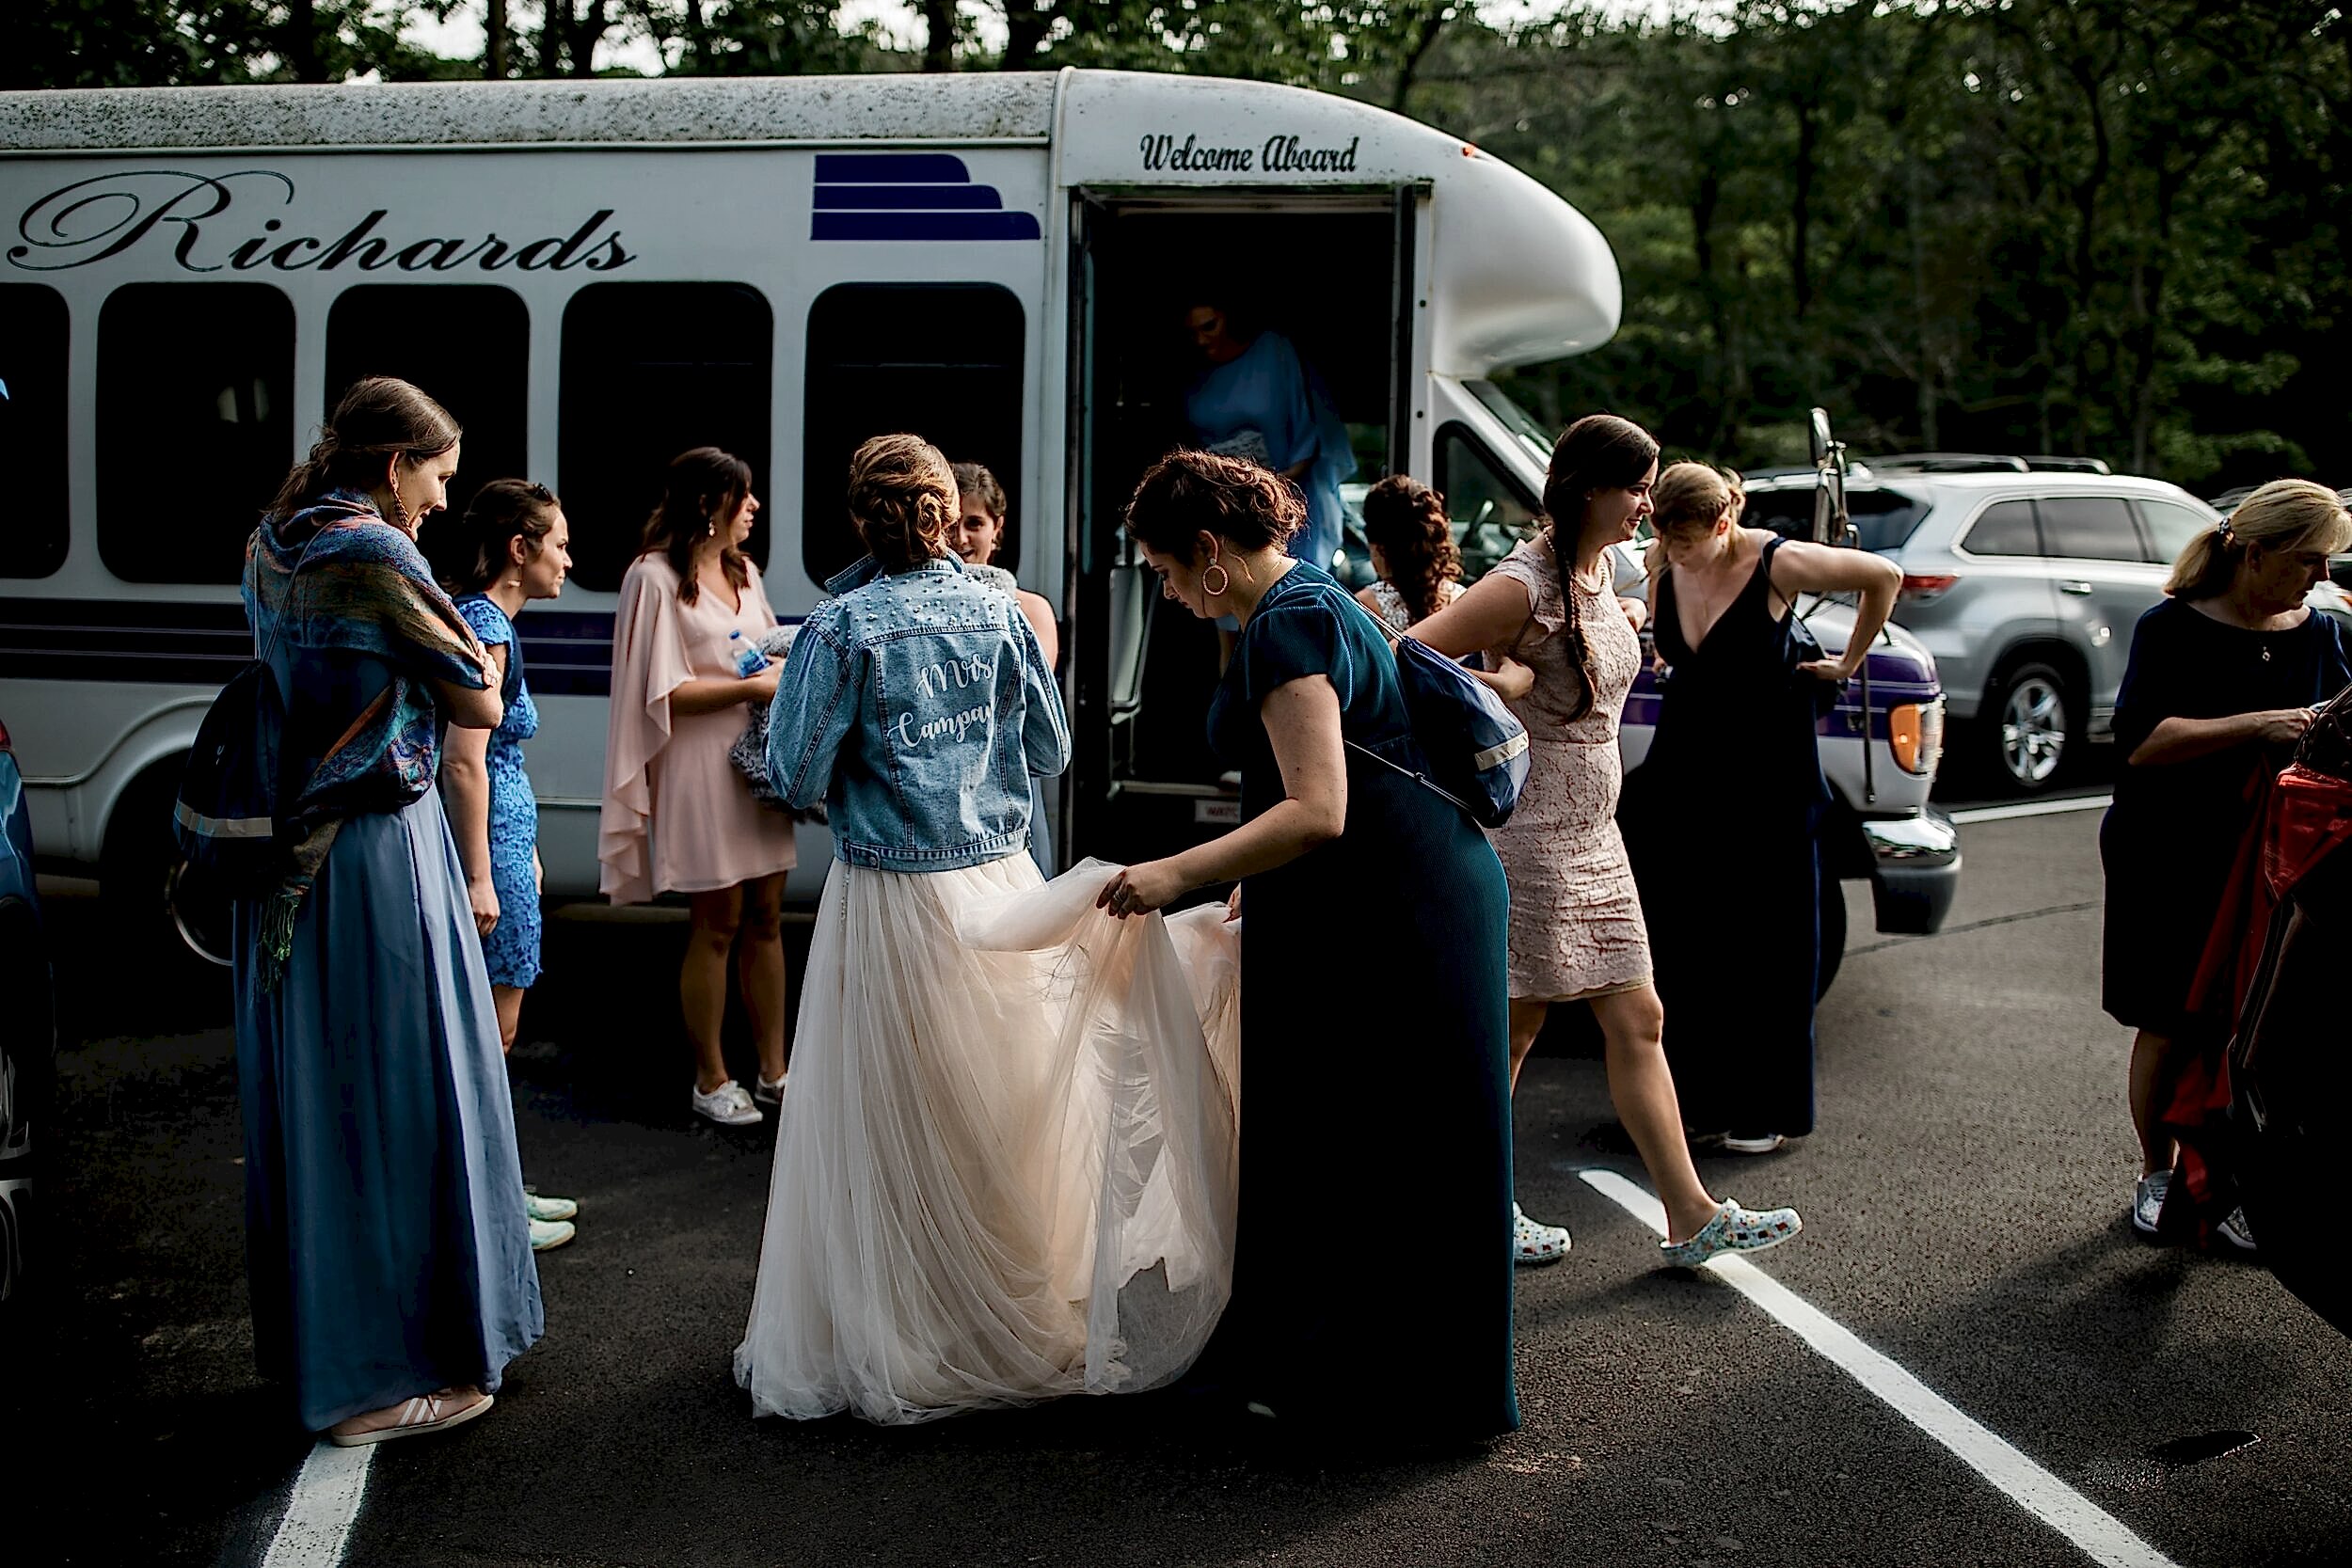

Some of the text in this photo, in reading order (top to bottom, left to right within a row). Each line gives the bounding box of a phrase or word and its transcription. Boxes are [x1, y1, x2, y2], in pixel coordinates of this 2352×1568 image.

[1140, 135, 1359, 172] Welcome Aboard
[7, 170, 637, 271] Richards
[915, 653, 993, 699] Mrs
